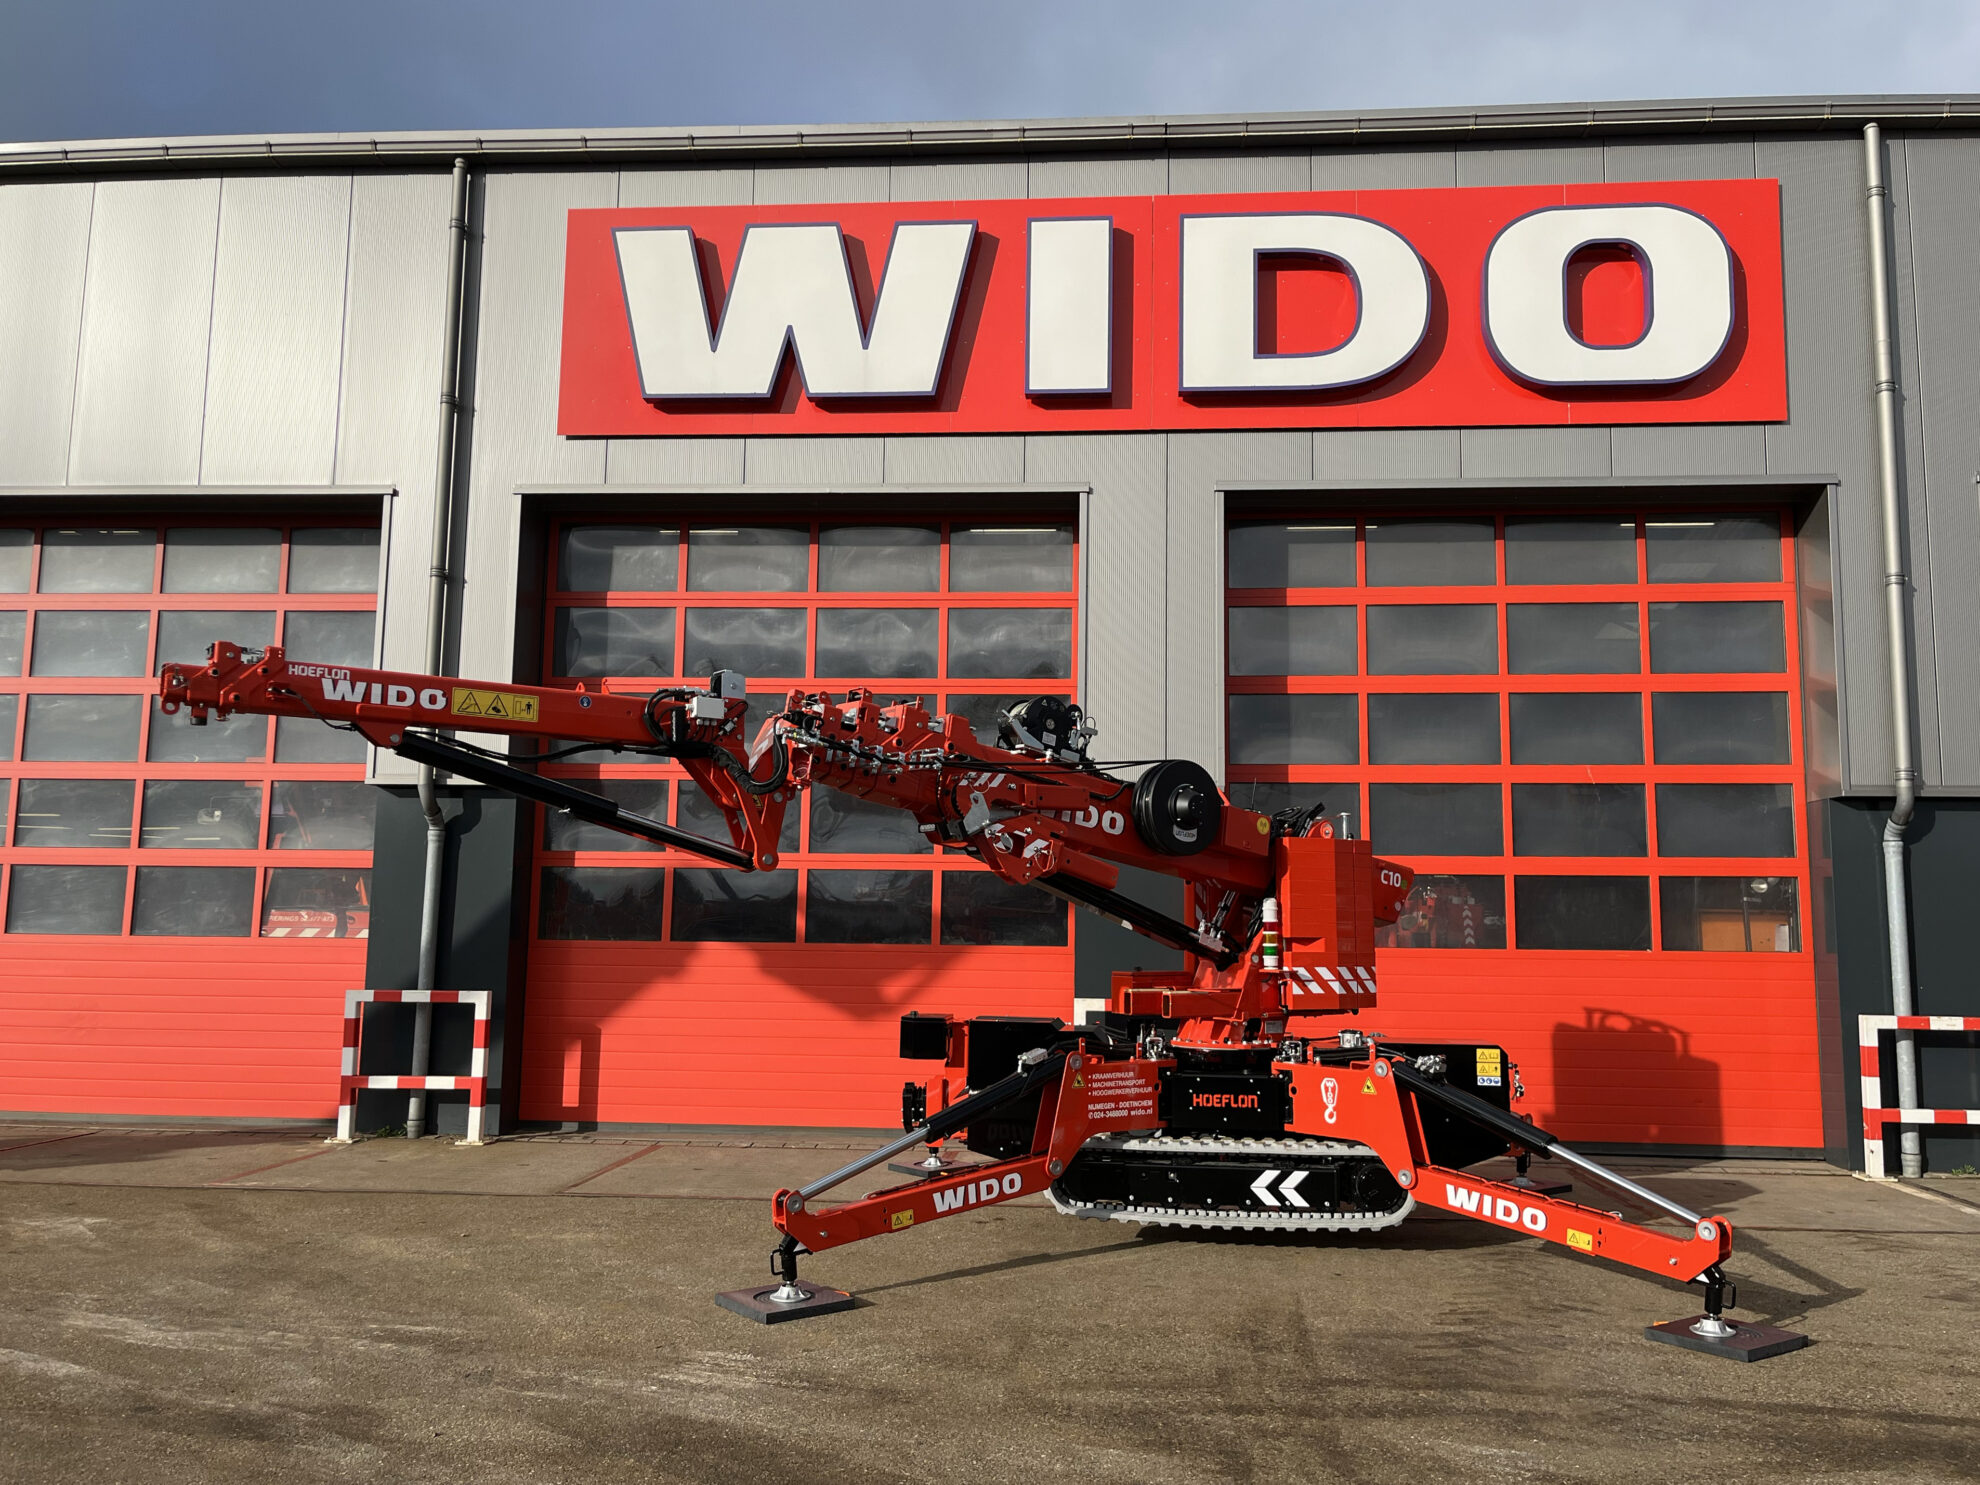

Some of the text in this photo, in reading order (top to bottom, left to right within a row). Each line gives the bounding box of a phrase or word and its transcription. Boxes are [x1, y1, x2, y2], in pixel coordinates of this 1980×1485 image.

[611, 204, 1736, 401] WIDO
[288, 664, 351, 680] HOEFLON
[321, 677, 448, 710] WIDO
[1380, 869, 1402, 888] C10
[1092, 1071, 1135, 1080] KRAANVERHUUR
[1092, 1078, 1146, 1088] MACHINETRANSPORT
[1092, 1086, 1153, 1096] HOOGWERKERVERHUUR
[1325, 1080, 1335, 1104] WIDO
[1087, 1102, 1116, 1111] NIJMEGEN
[1119, 1100, 1153, 1109] DOETINCHEM
[1192, 1093, 1259, 1109] HOEFLON
[1130, 1107, 1153, 1116] wido.nl
[932, 1172, 1022, 1213] WIDO
[1445, 1183, 1547, 1232] WIDO
